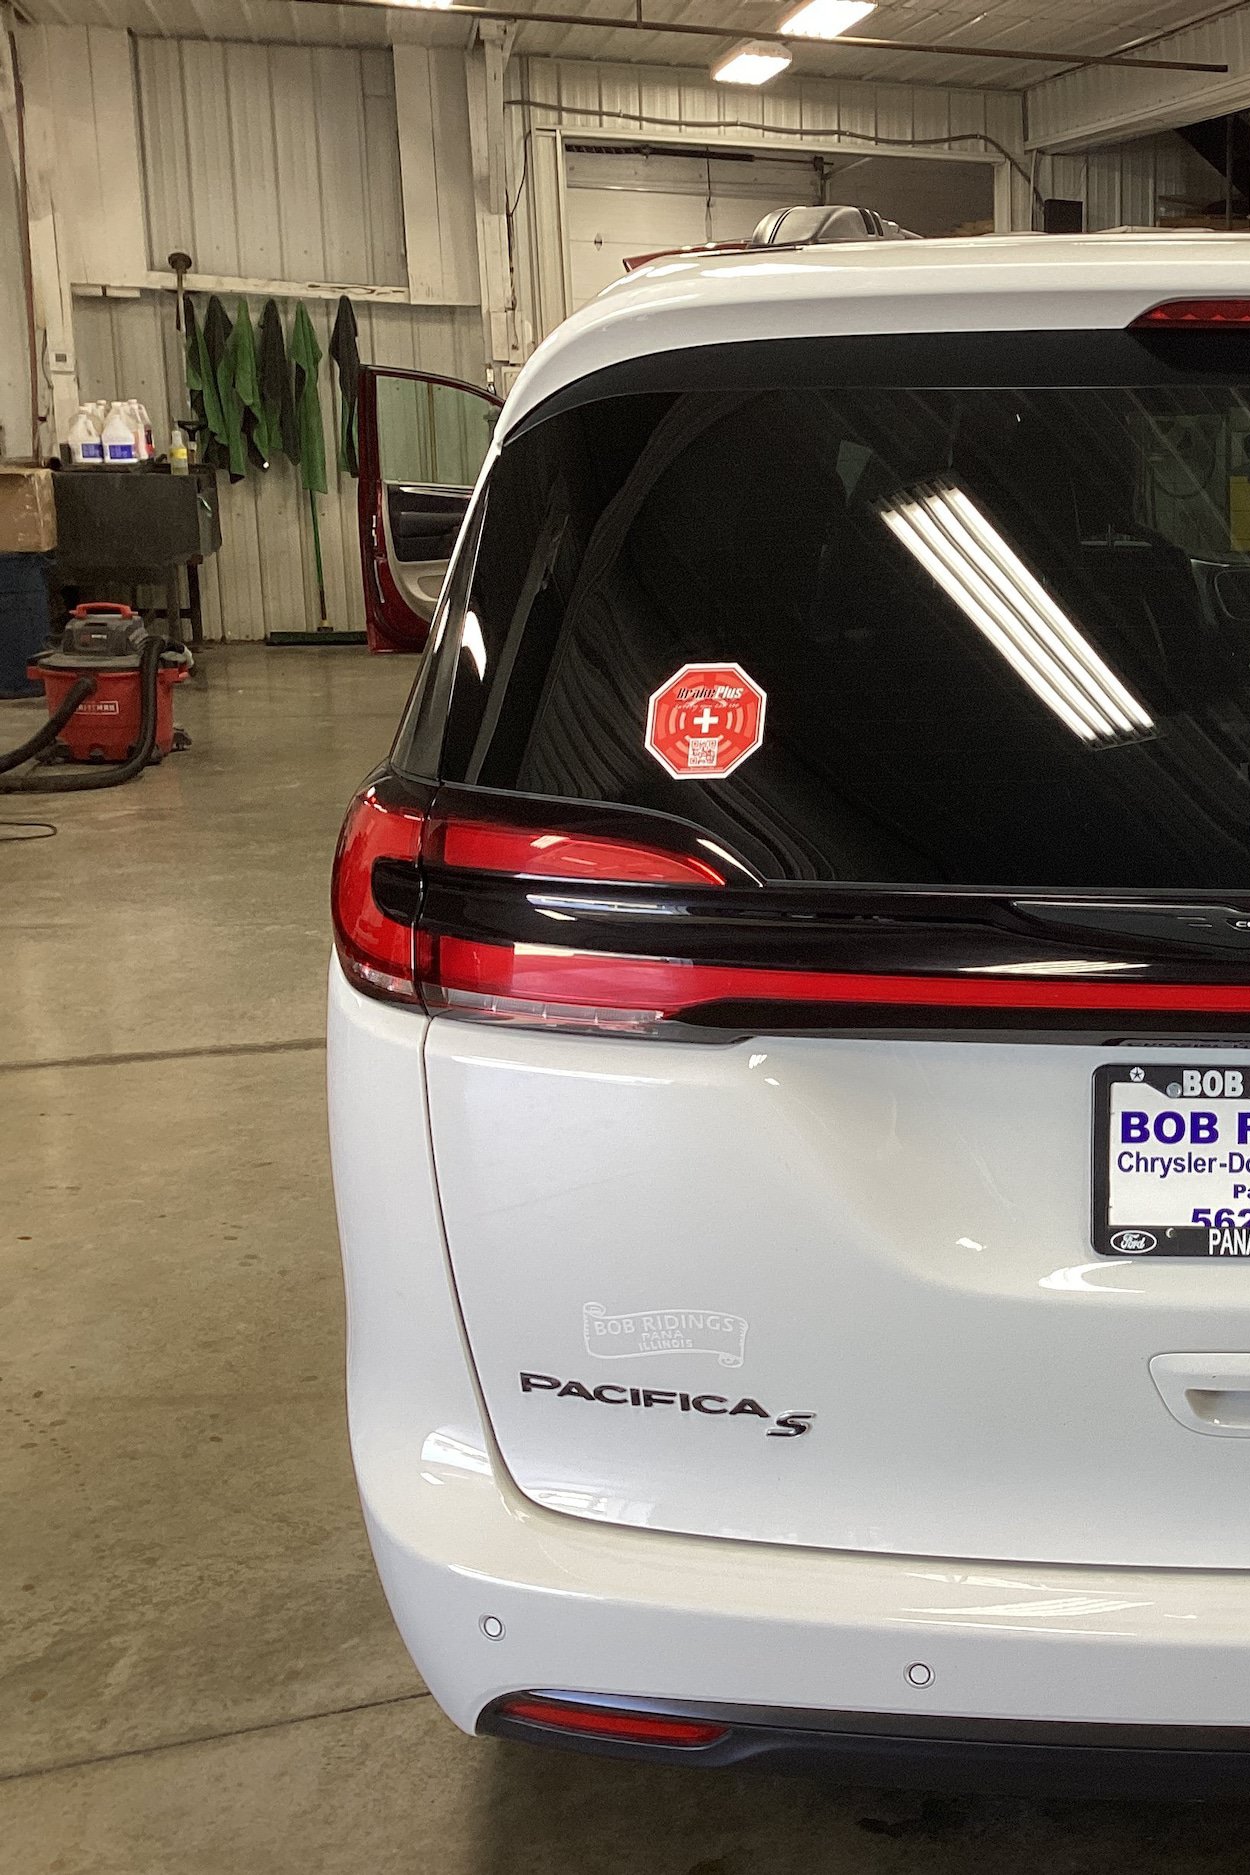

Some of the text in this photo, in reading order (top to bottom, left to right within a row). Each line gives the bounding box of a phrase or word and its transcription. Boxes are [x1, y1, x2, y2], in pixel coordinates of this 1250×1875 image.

[1182, 1070, 1244, 1097] BOB
[1121, 1111, 1219, 1144] BOB
[1120, 1233, 1146, 1249] Ford
[594, 1314, 734, 1336] BOB RIDINGS
[641, 1330, 684, 1341] PANA
[638, 1339, 694, 1351] ILLINOIS
[519, 1372, 816, 1438] PACIFICA S
